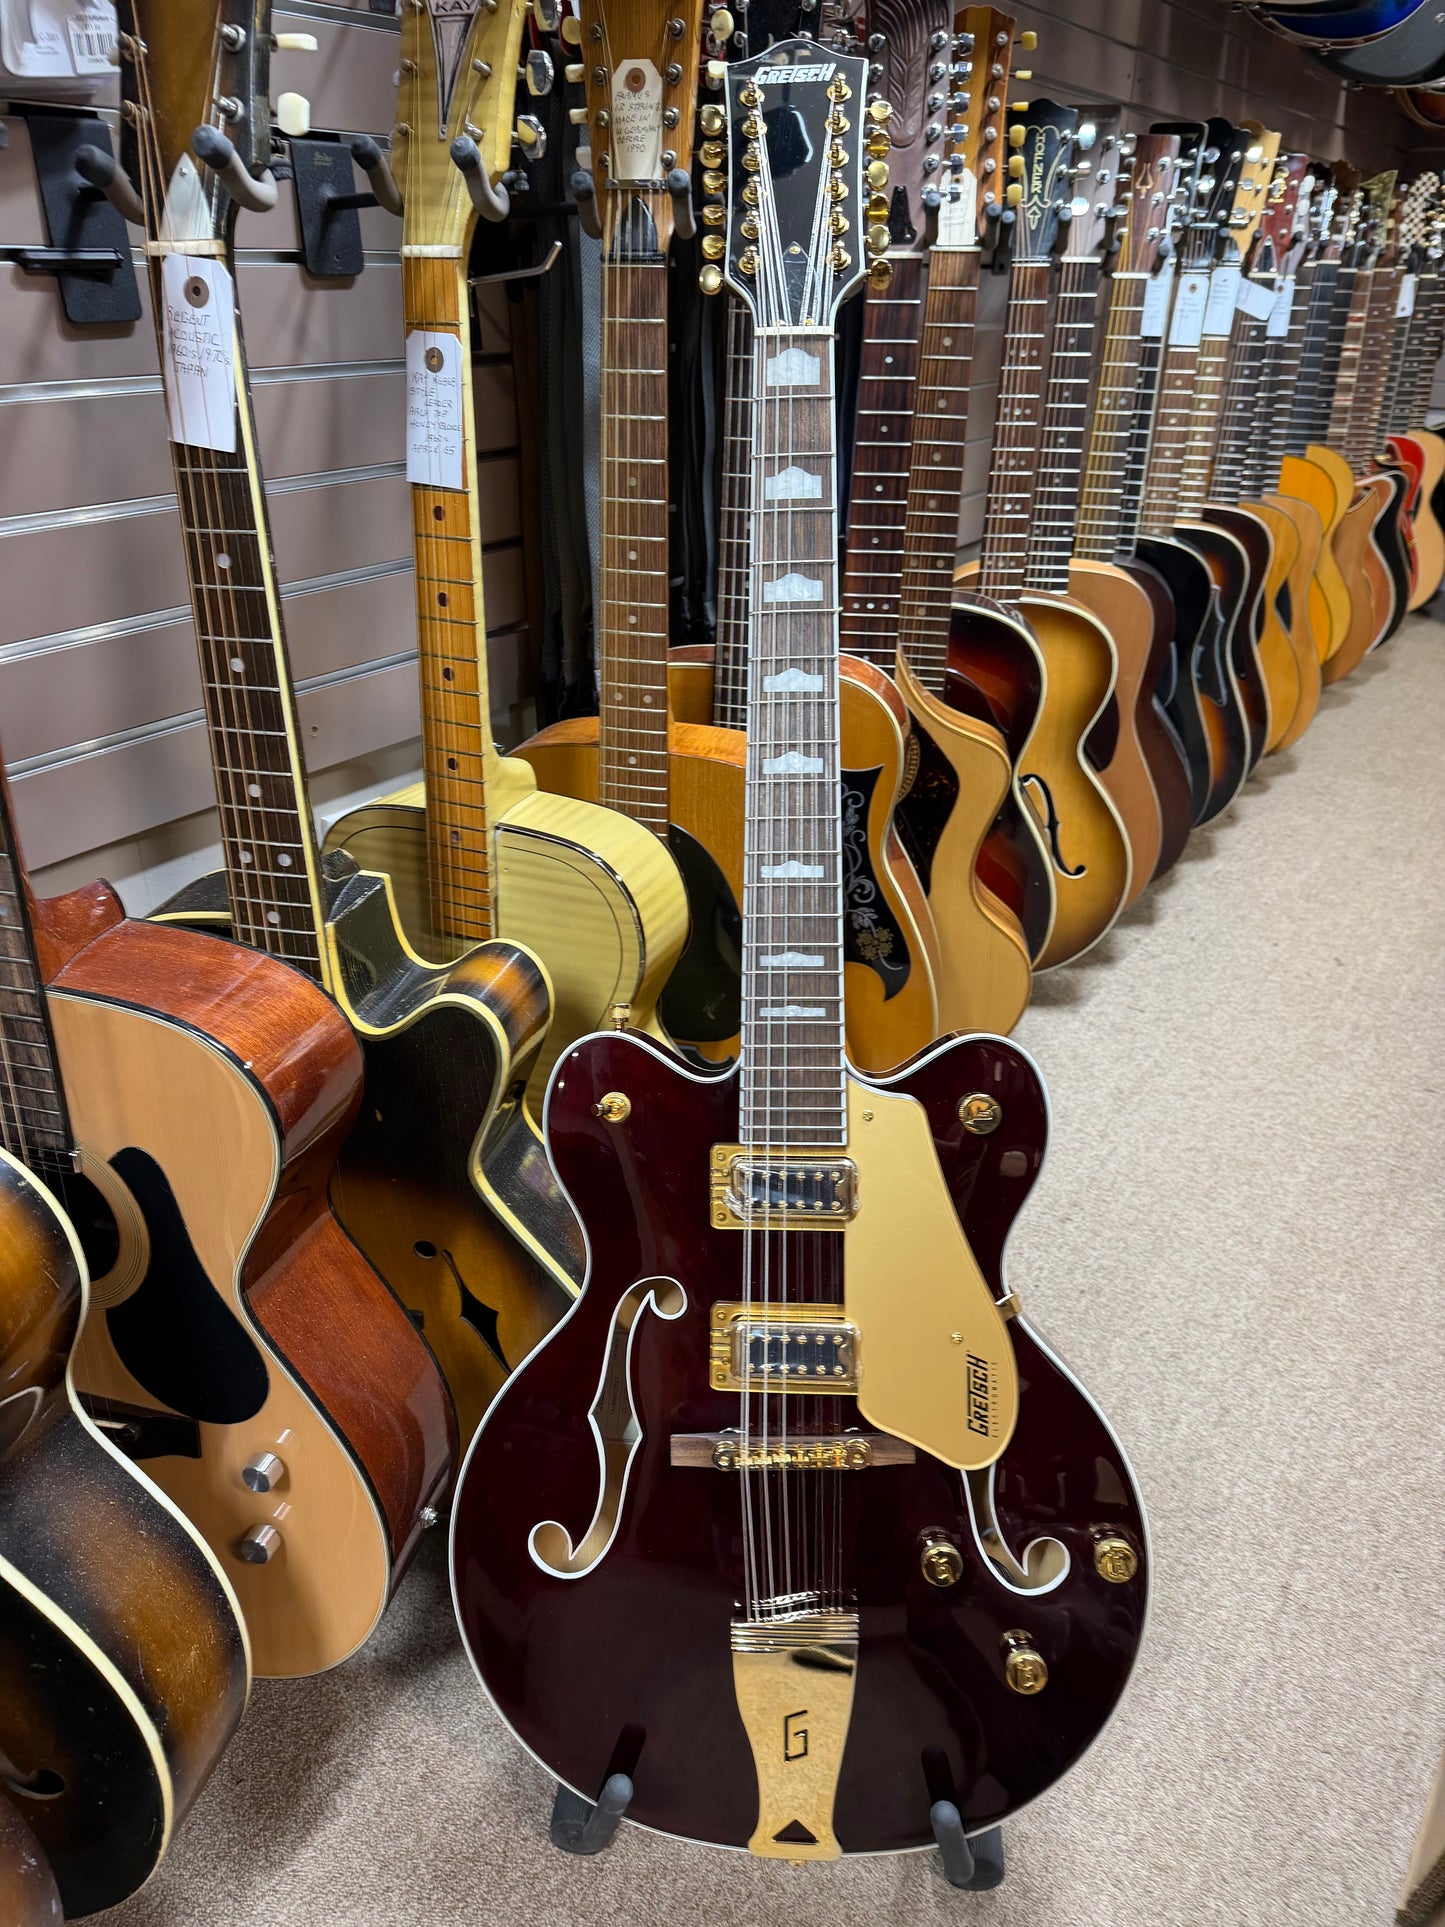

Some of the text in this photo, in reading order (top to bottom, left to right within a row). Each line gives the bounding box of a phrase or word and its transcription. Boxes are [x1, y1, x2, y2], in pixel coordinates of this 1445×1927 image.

[435, 0, 471, 13] KAY
[753, 62, 837, 85] GRETSCH
[966, 1352, 989, 1438] GRETSCH
[784, 1709, 808, 1762] G
